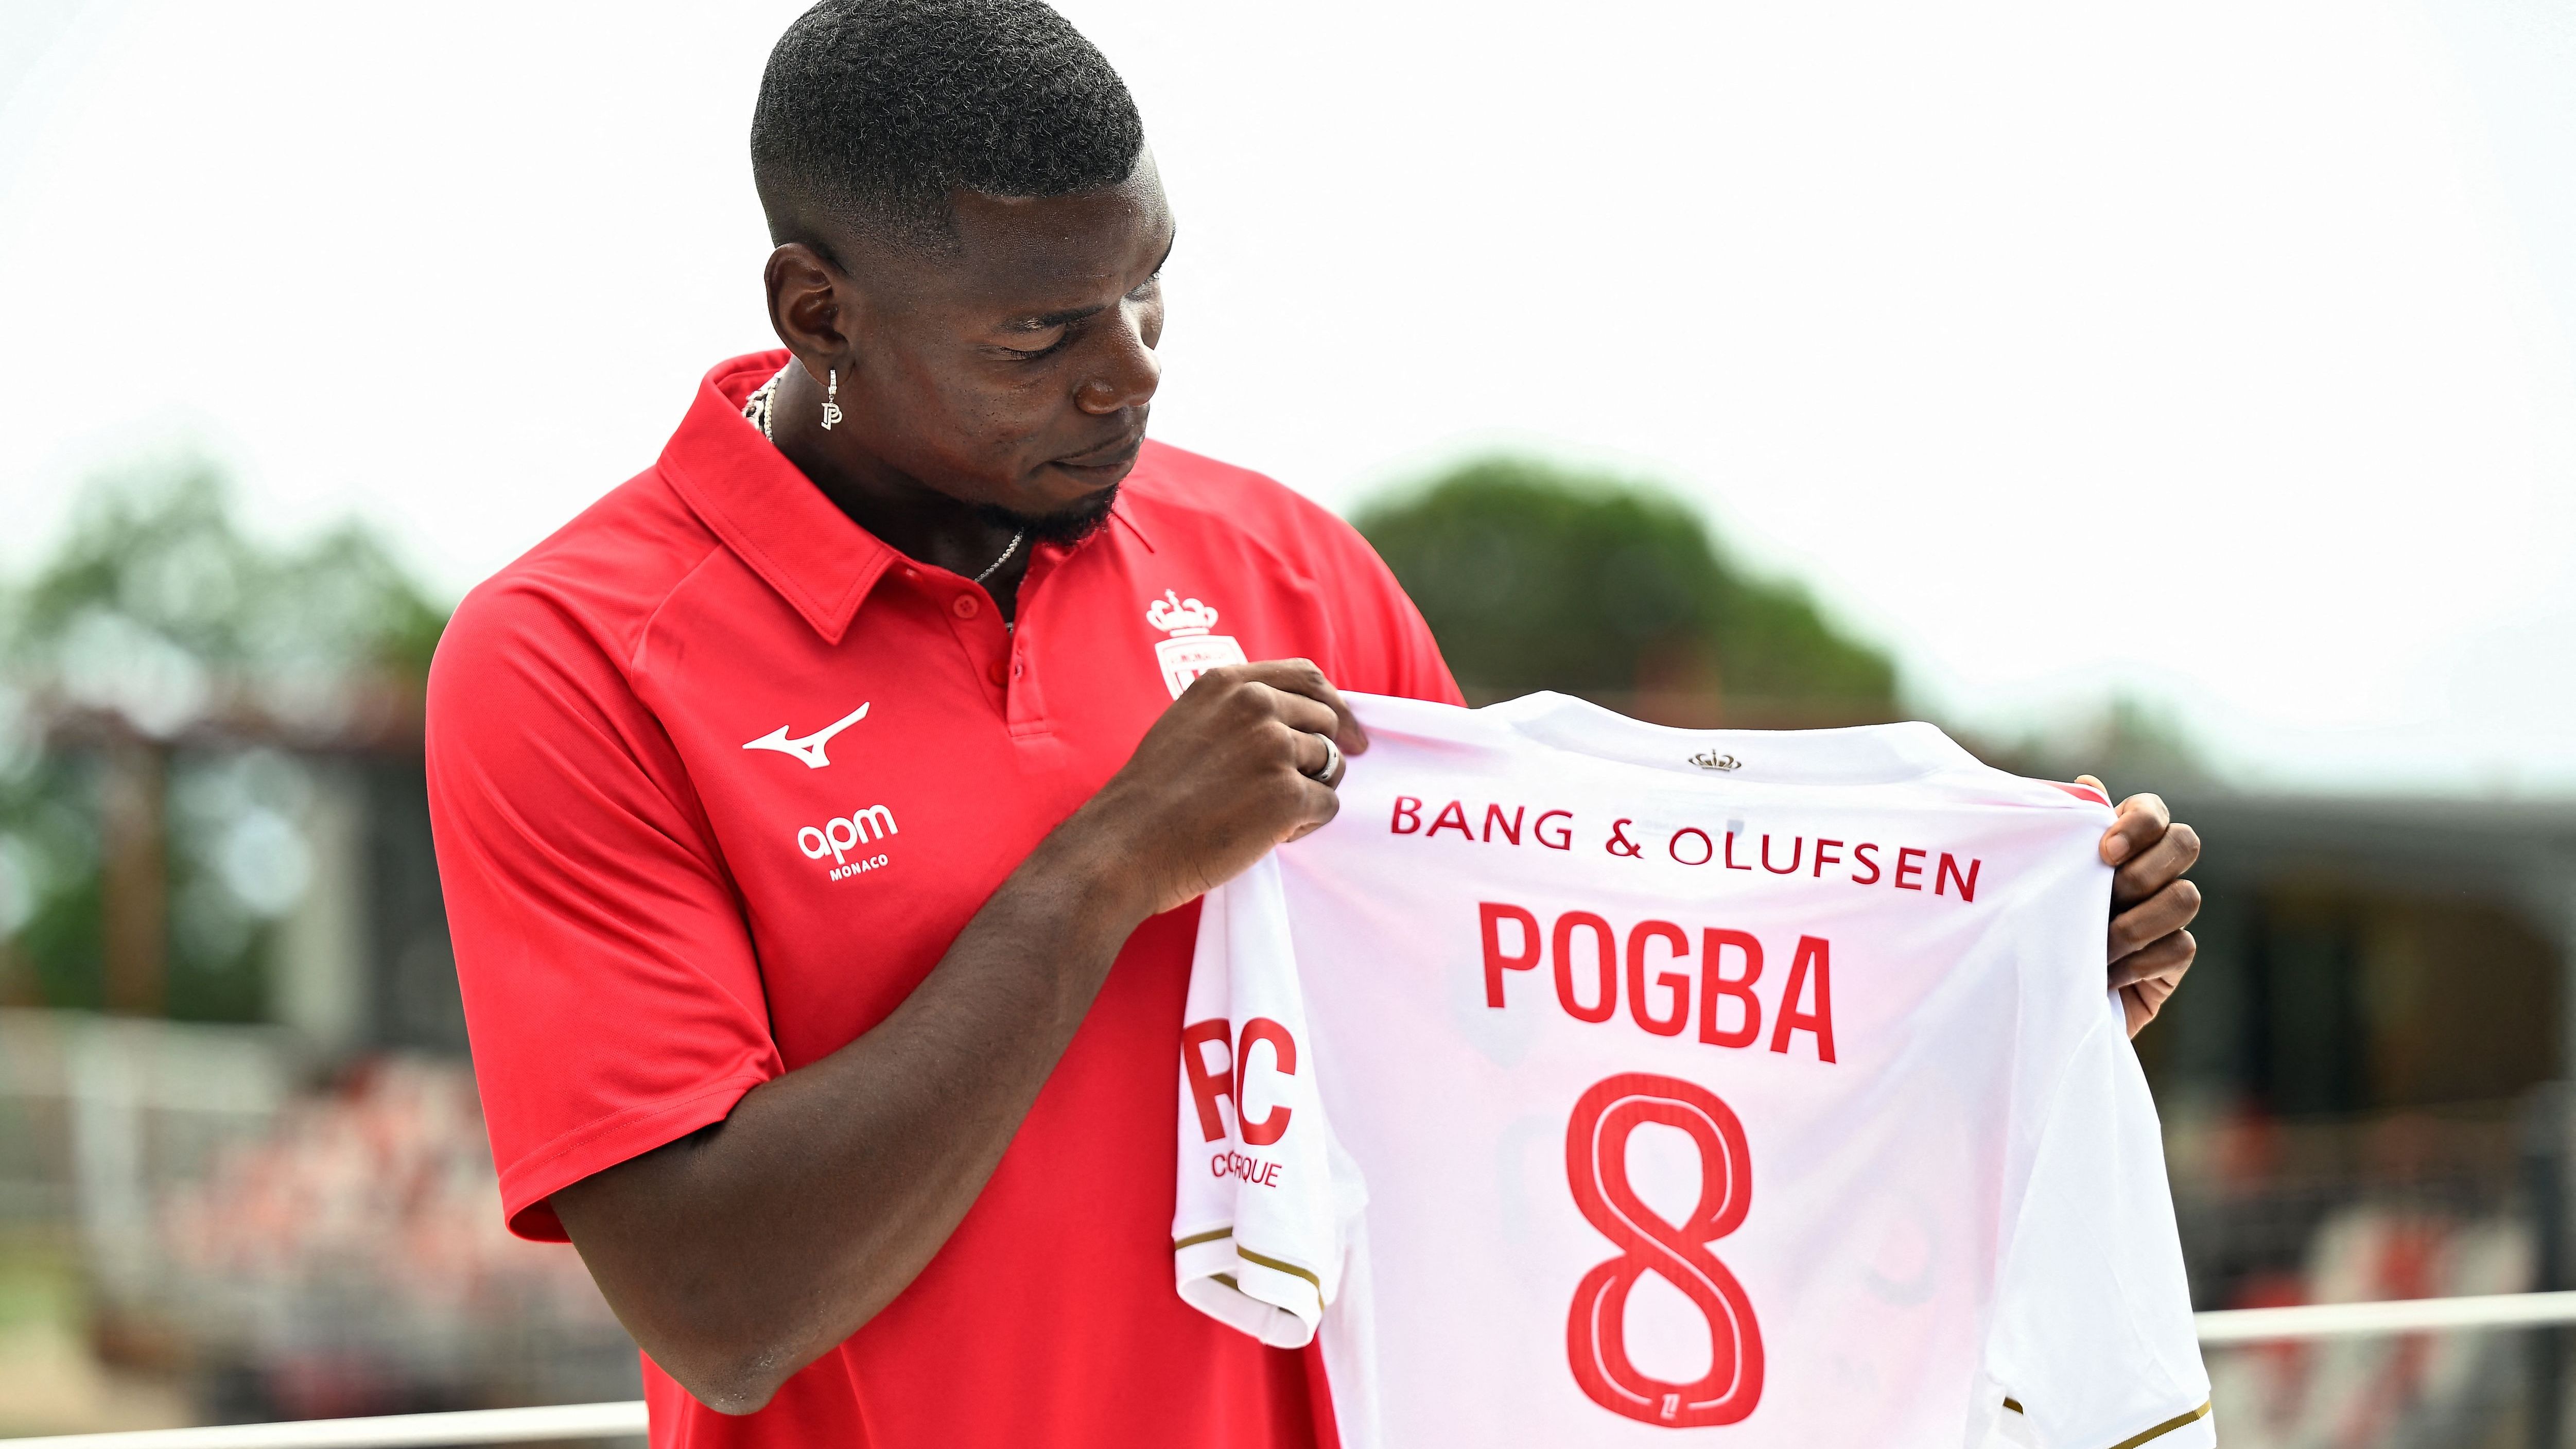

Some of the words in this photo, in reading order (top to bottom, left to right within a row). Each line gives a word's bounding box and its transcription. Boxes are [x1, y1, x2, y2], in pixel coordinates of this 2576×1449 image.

[797, 805, 898, 865] apm
[829, 854, 889, 882] MONACO
[1391, 796, 1573, 851] BANG
[1606, 818, 1642, 859] &
[1669, 827, 1982, 903] OLUFSEN
[1478, 901, 1837, 1065] POGBA
[1565, 1071, 1766, 1430] 8
